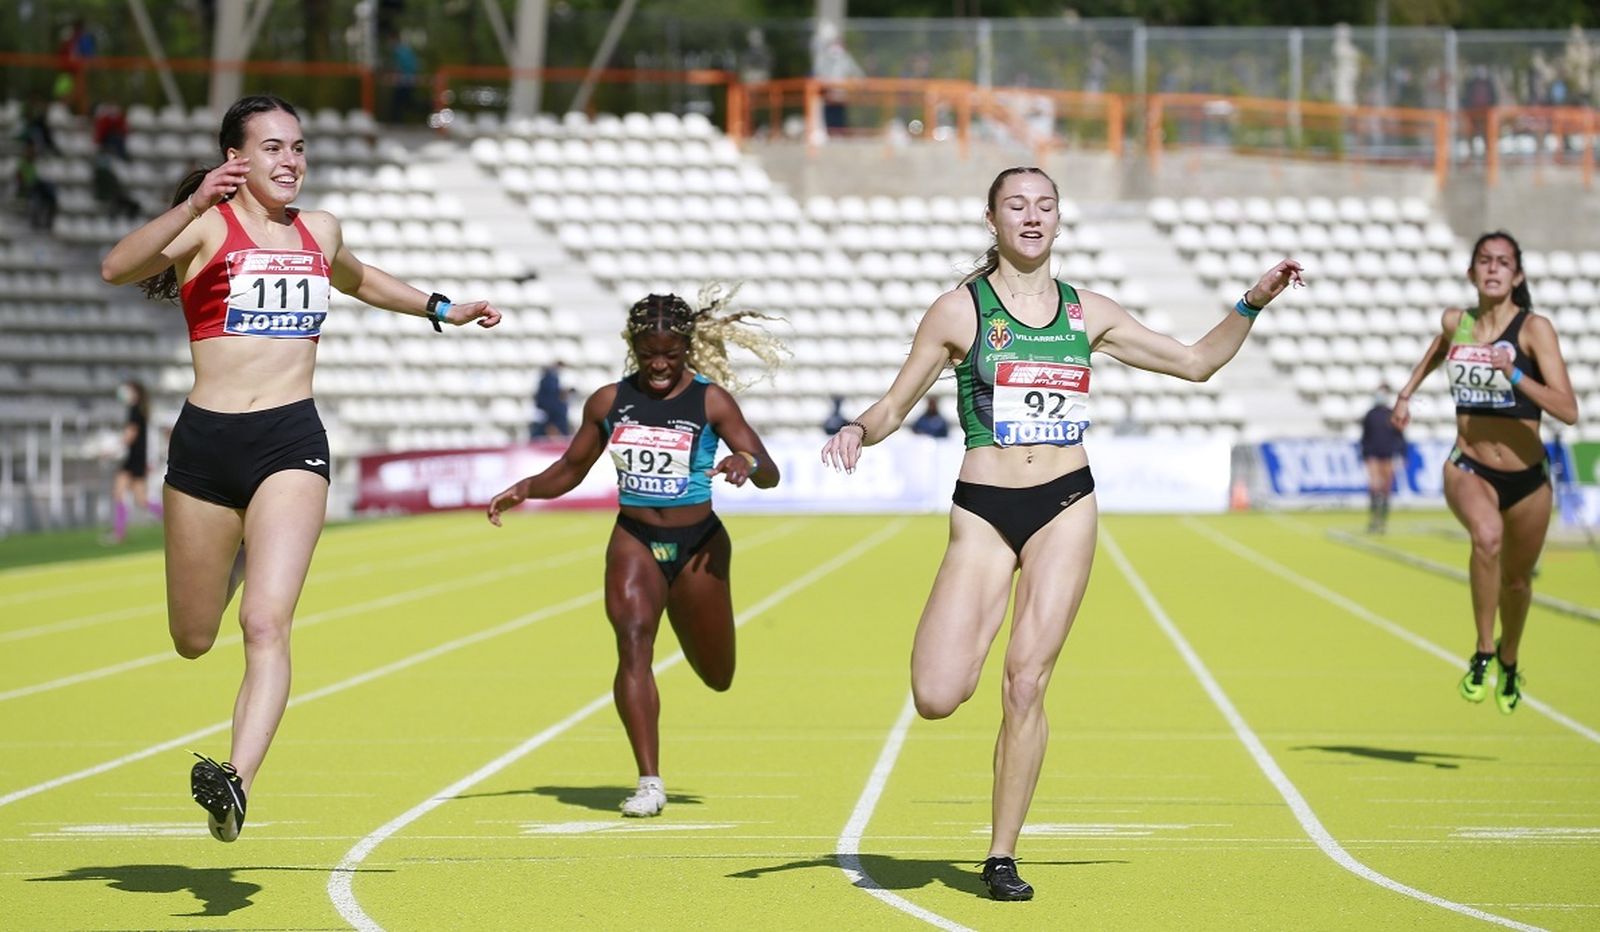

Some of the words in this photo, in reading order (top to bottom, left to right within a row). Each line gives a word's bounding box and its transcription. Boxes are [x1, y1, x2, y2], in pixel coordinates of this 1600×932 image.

[252, 278, 309, 309] 111
[1015, 333, 1065, 342] VILLARREAL
[1454, 364, 1497, 388] 262
[1023, 390, 1067, 419] 92
[622, 448, 673, 474] 192
